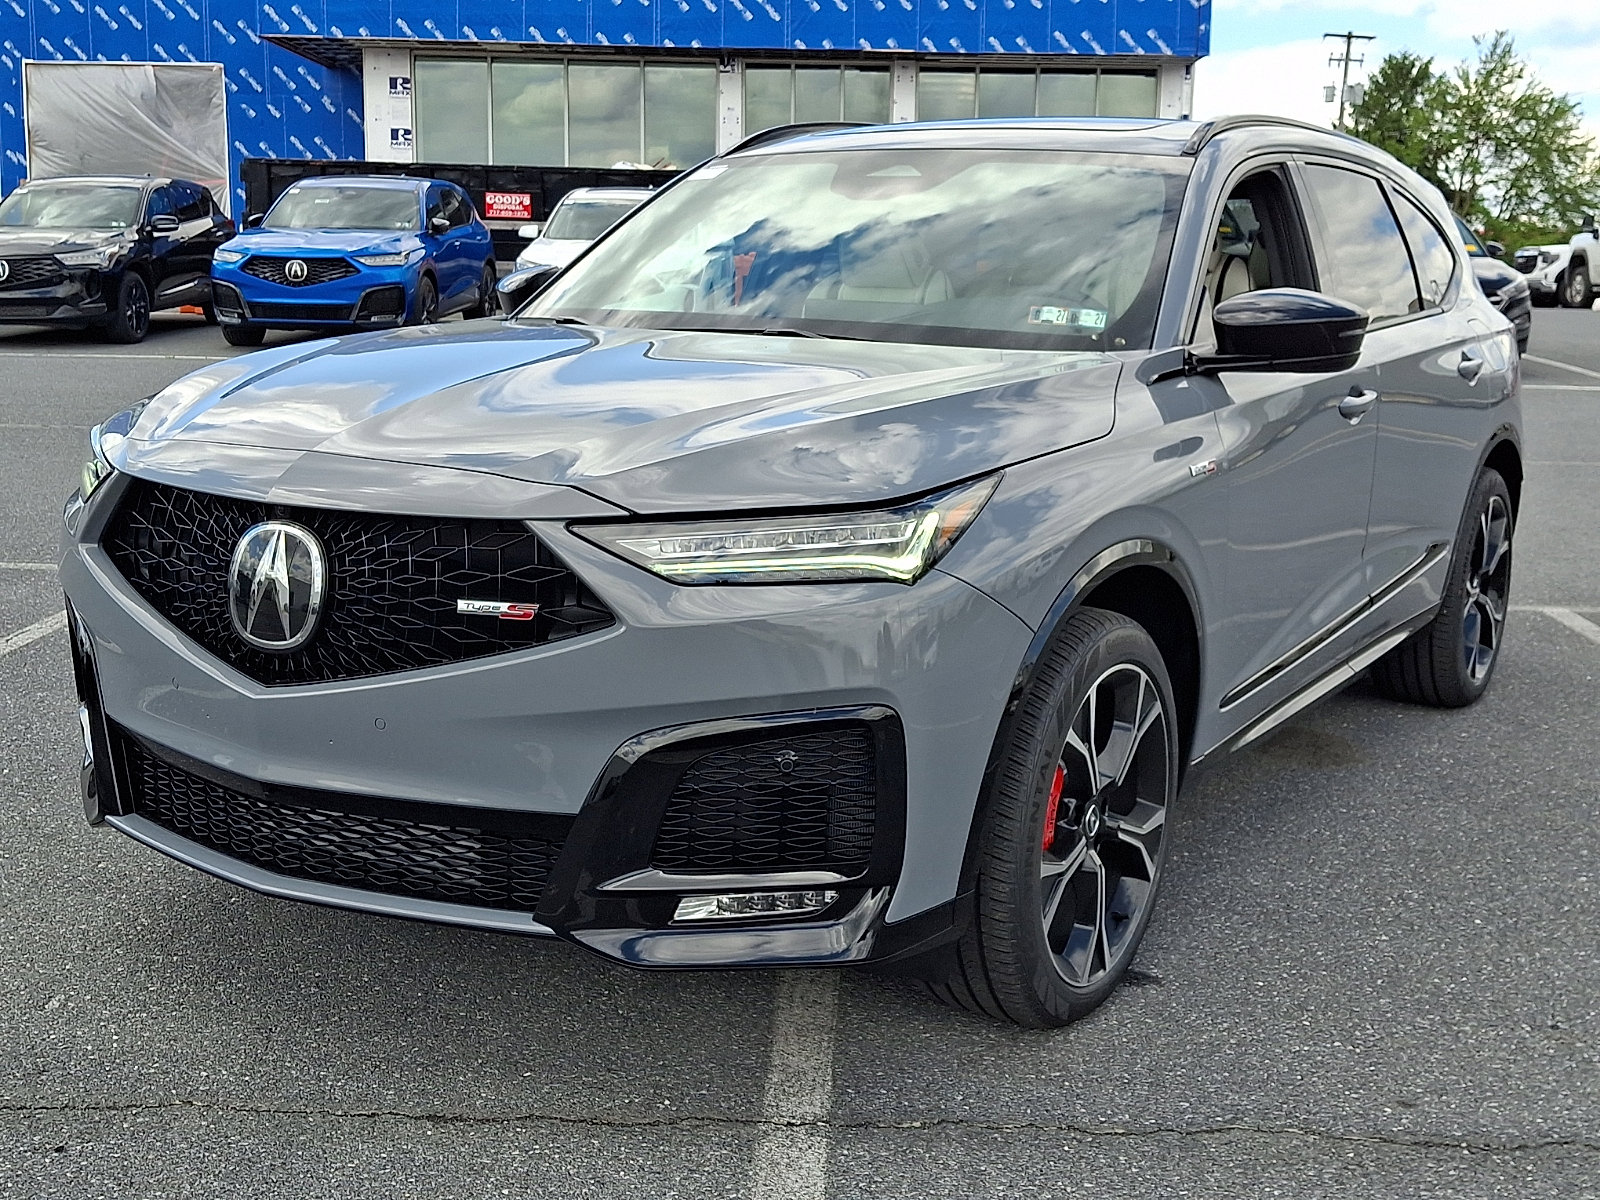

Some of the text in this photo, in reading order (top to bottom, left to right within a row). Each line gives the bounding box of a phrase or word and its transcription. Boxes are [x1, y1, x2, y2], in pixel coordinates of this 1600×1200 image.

[486, 195, 531, 206] GOOD'S
[493, 203, 525, 211] DISPOSAL
[1056, 309, 1067, 322] 27
[1094, 313, 1105, 326] 27
[463, 602, 539, 620] Type S
